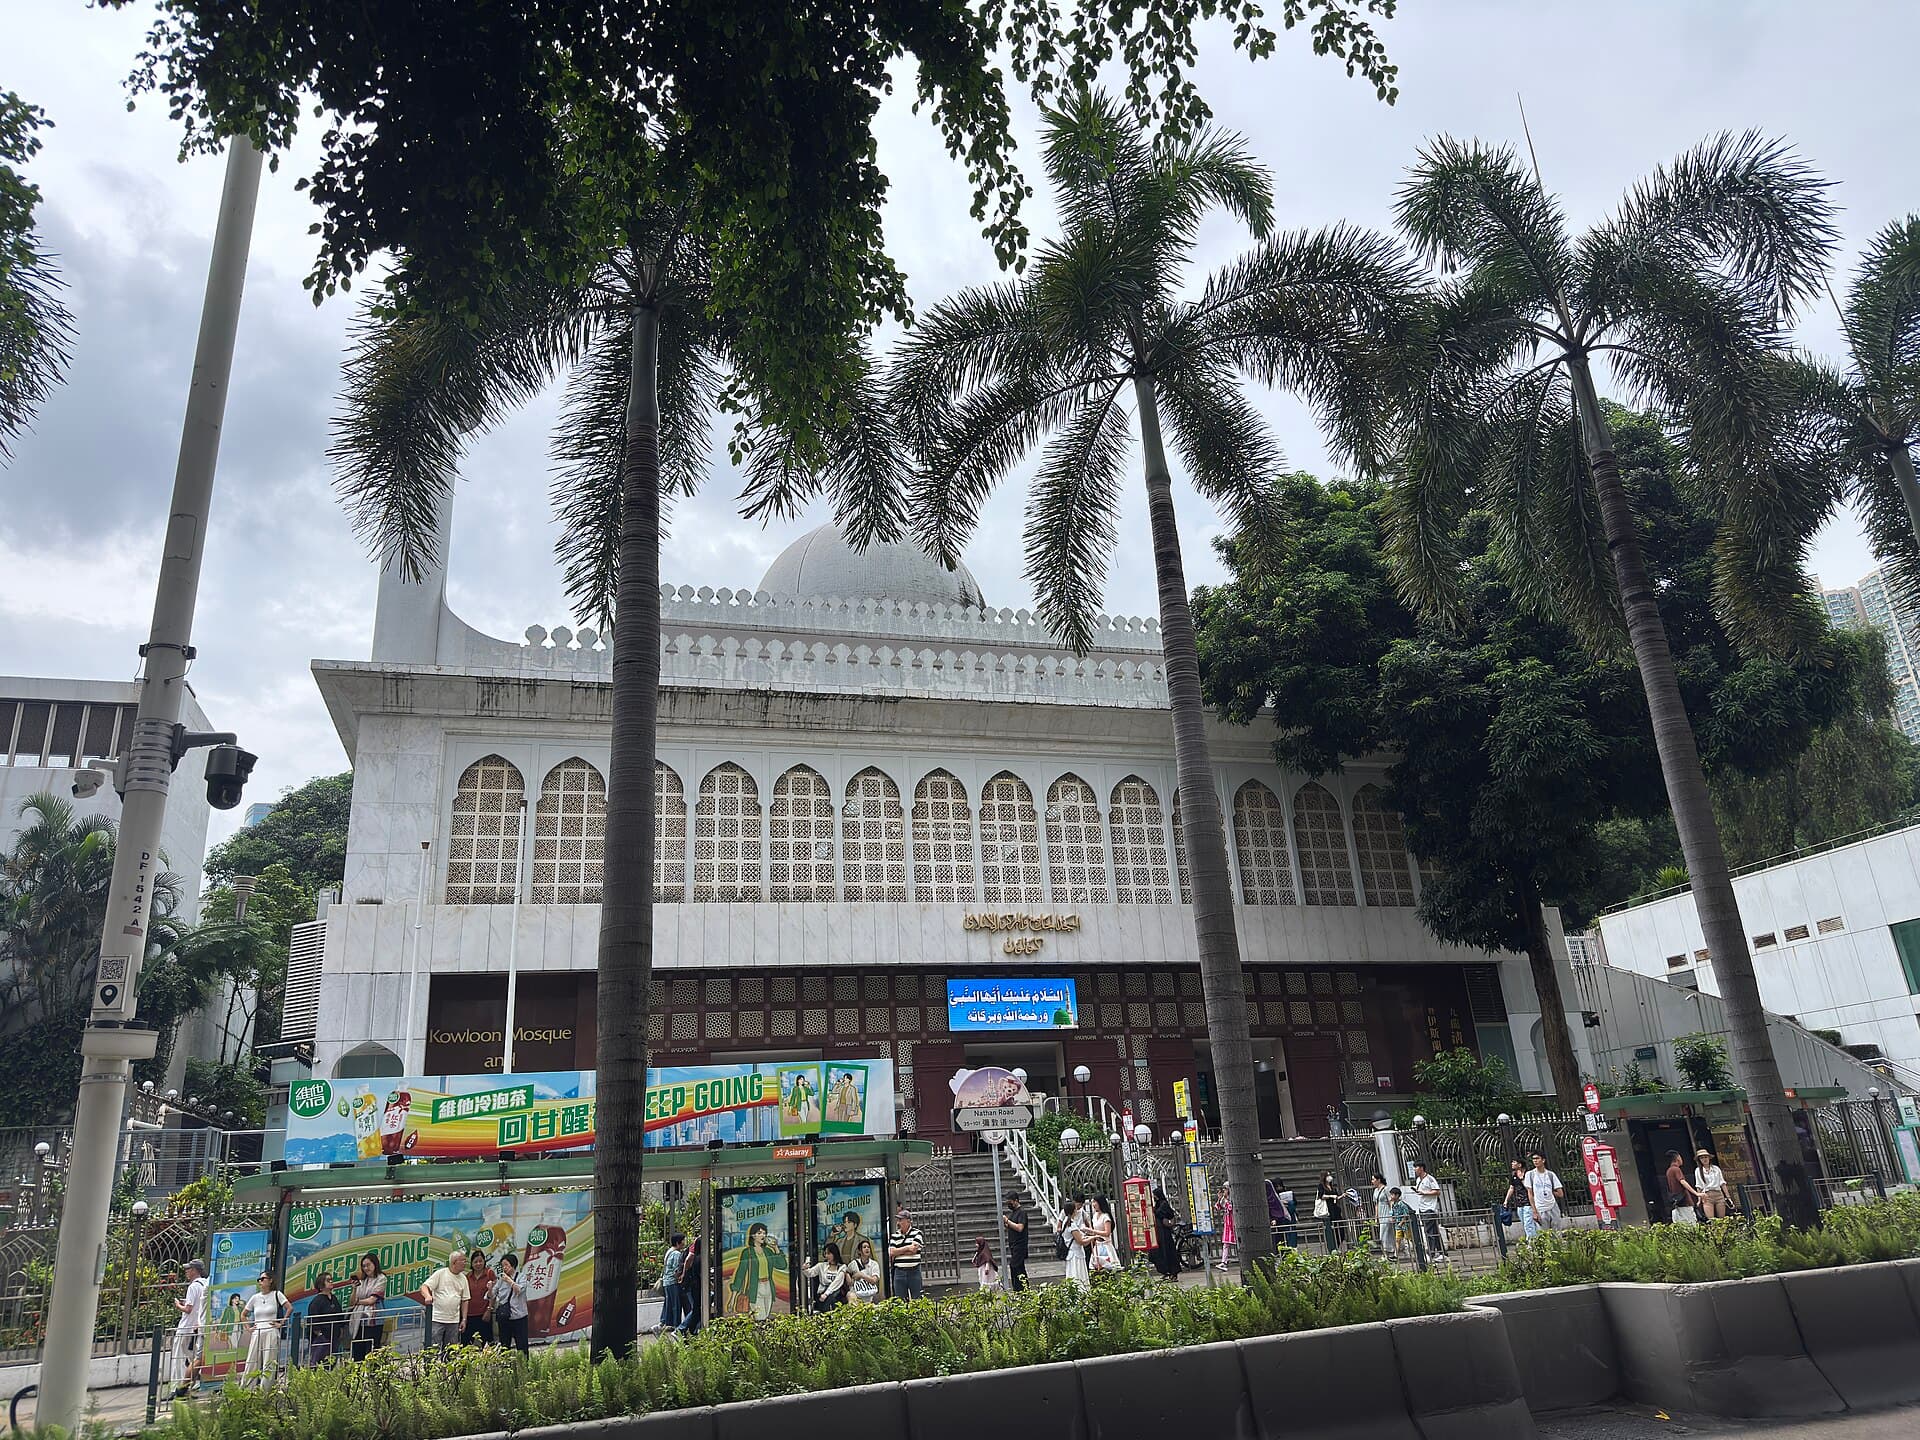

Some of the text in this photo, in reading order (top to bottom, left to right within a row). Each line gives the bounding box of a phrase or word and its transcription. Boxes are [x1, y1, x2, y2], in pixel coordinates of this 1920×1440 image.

[428, 1026, 572, 1044] Kowloon Mosque
[437, 1089, 528, 1119] 維他冷泡茶
[645, 1072, 764, 1120] EEP GOING
[974, 1108, 1014, 1117] Nathan Road
[784, 1147, 809, 1157] Asiaray
[826, 1202, 846, 1216] KEEP
[847, 1193, 871, 1210] GOING
[533, 1265, 547, 1290] 紅茶
